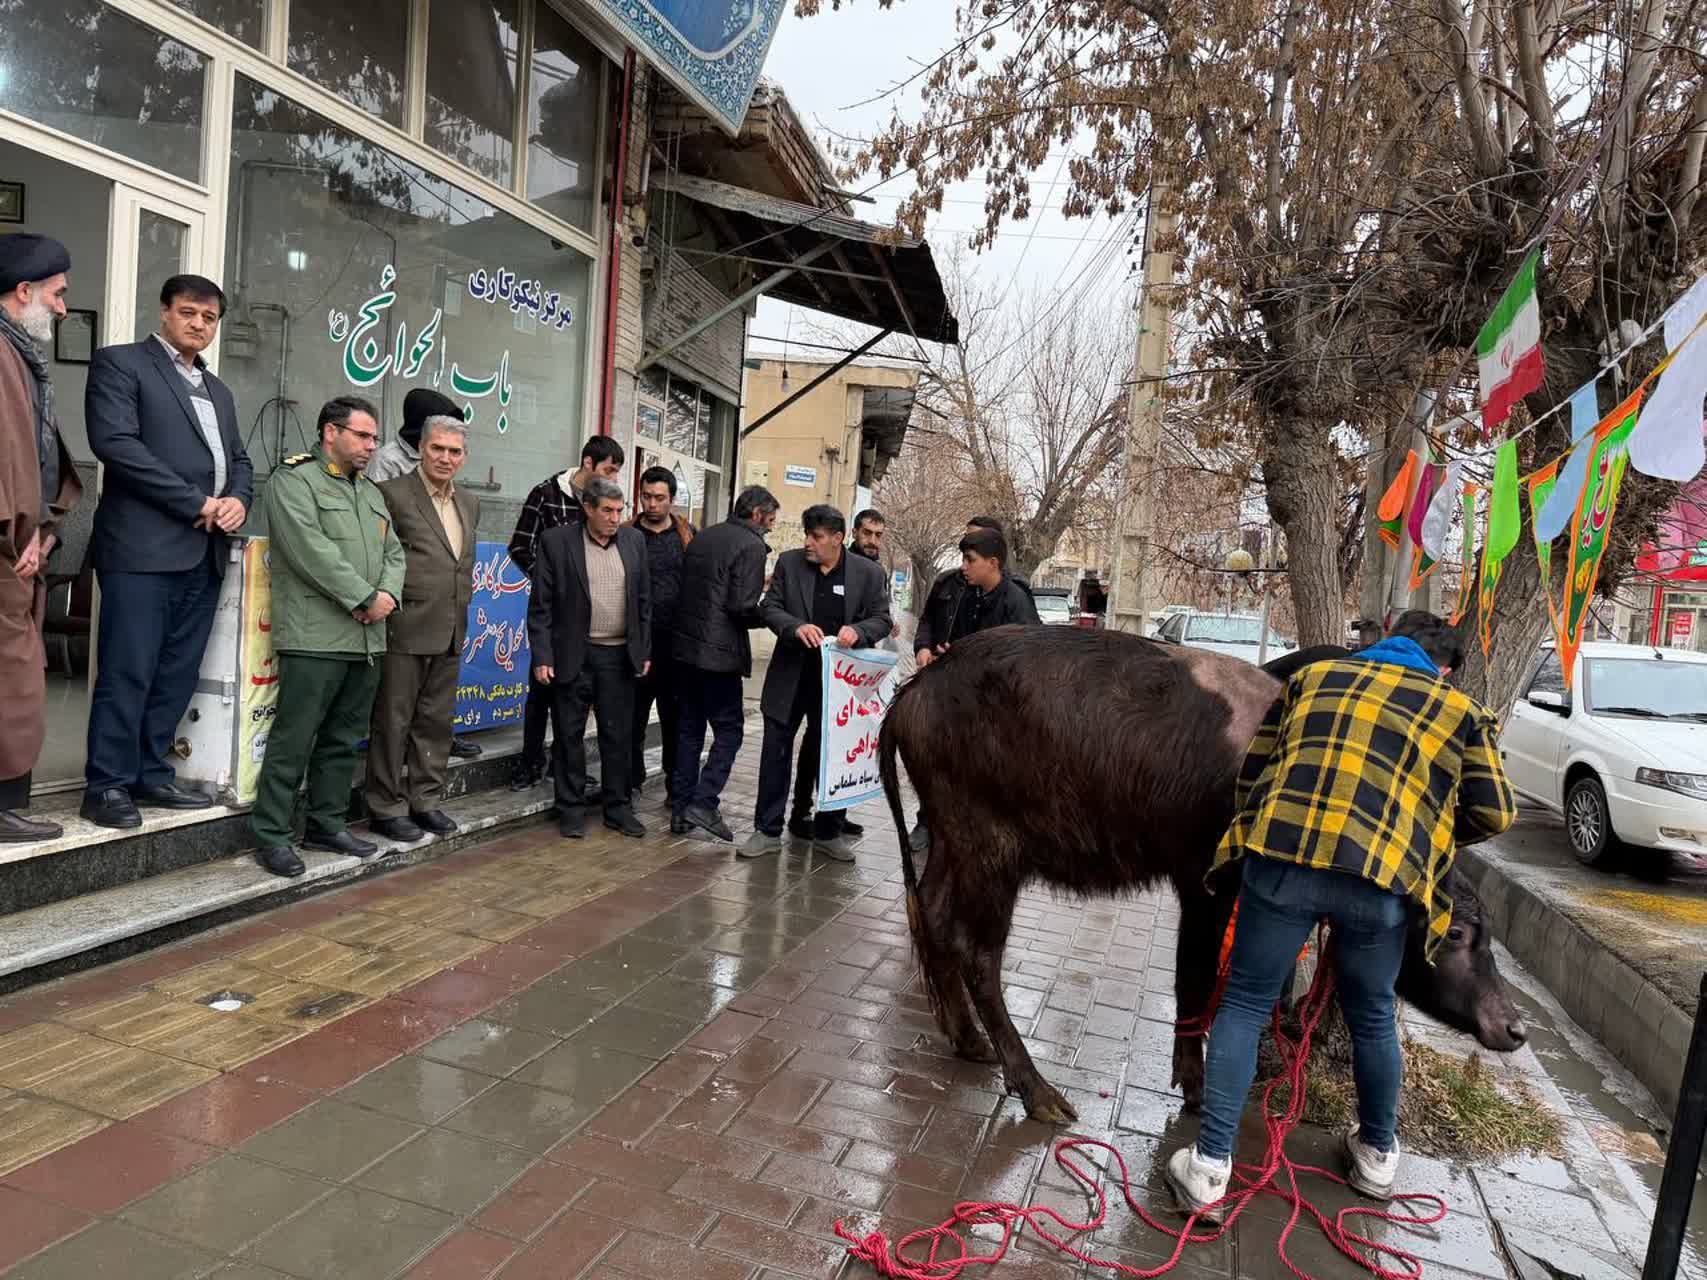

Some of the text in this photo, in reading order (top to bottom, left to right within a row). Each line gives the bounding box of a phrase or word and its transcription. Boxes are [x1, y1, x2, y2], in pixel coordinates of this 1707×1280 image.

[468, 266, 573, 331] مرکز نیکوکاری
[449, 349, 513, 434] باب
